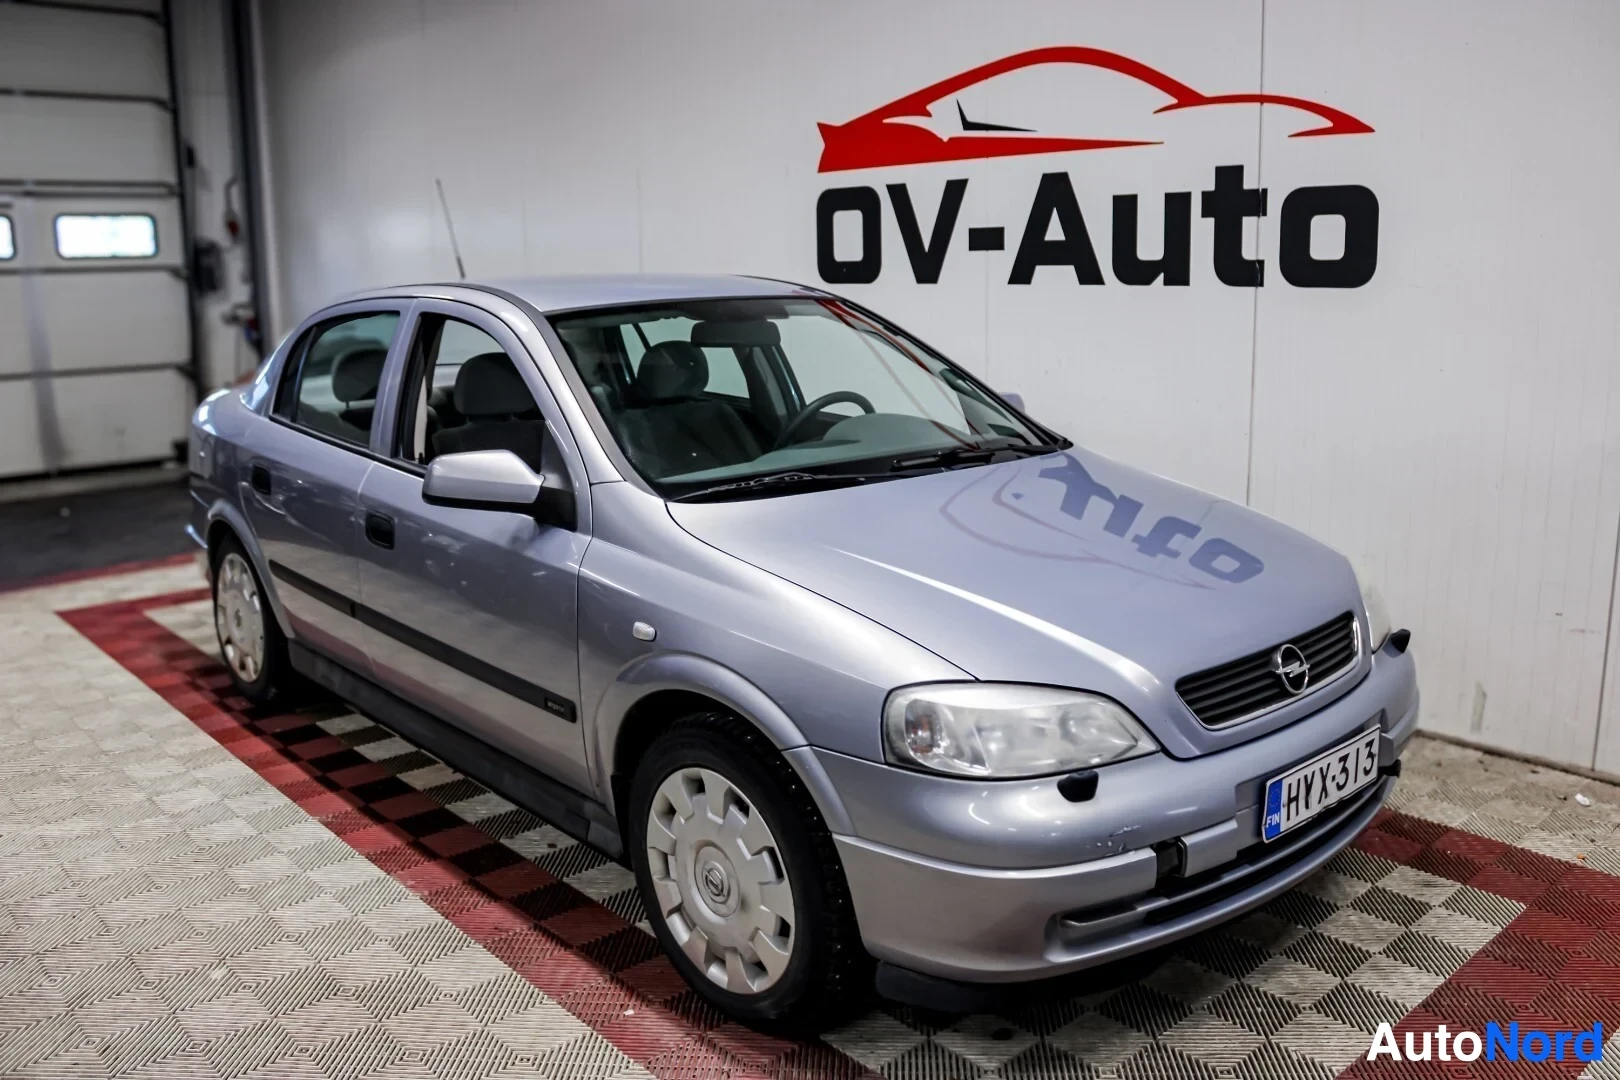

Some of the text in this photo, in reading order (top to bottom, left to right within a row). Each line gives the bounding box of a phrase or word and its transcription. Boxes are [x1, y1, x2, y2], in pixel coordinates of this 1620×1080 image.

[816, 164, 1380, 289] OV-Auto
[1266, 812, 1281, 828] FIN
[1286, 737, 1376, 822] HYX-313
